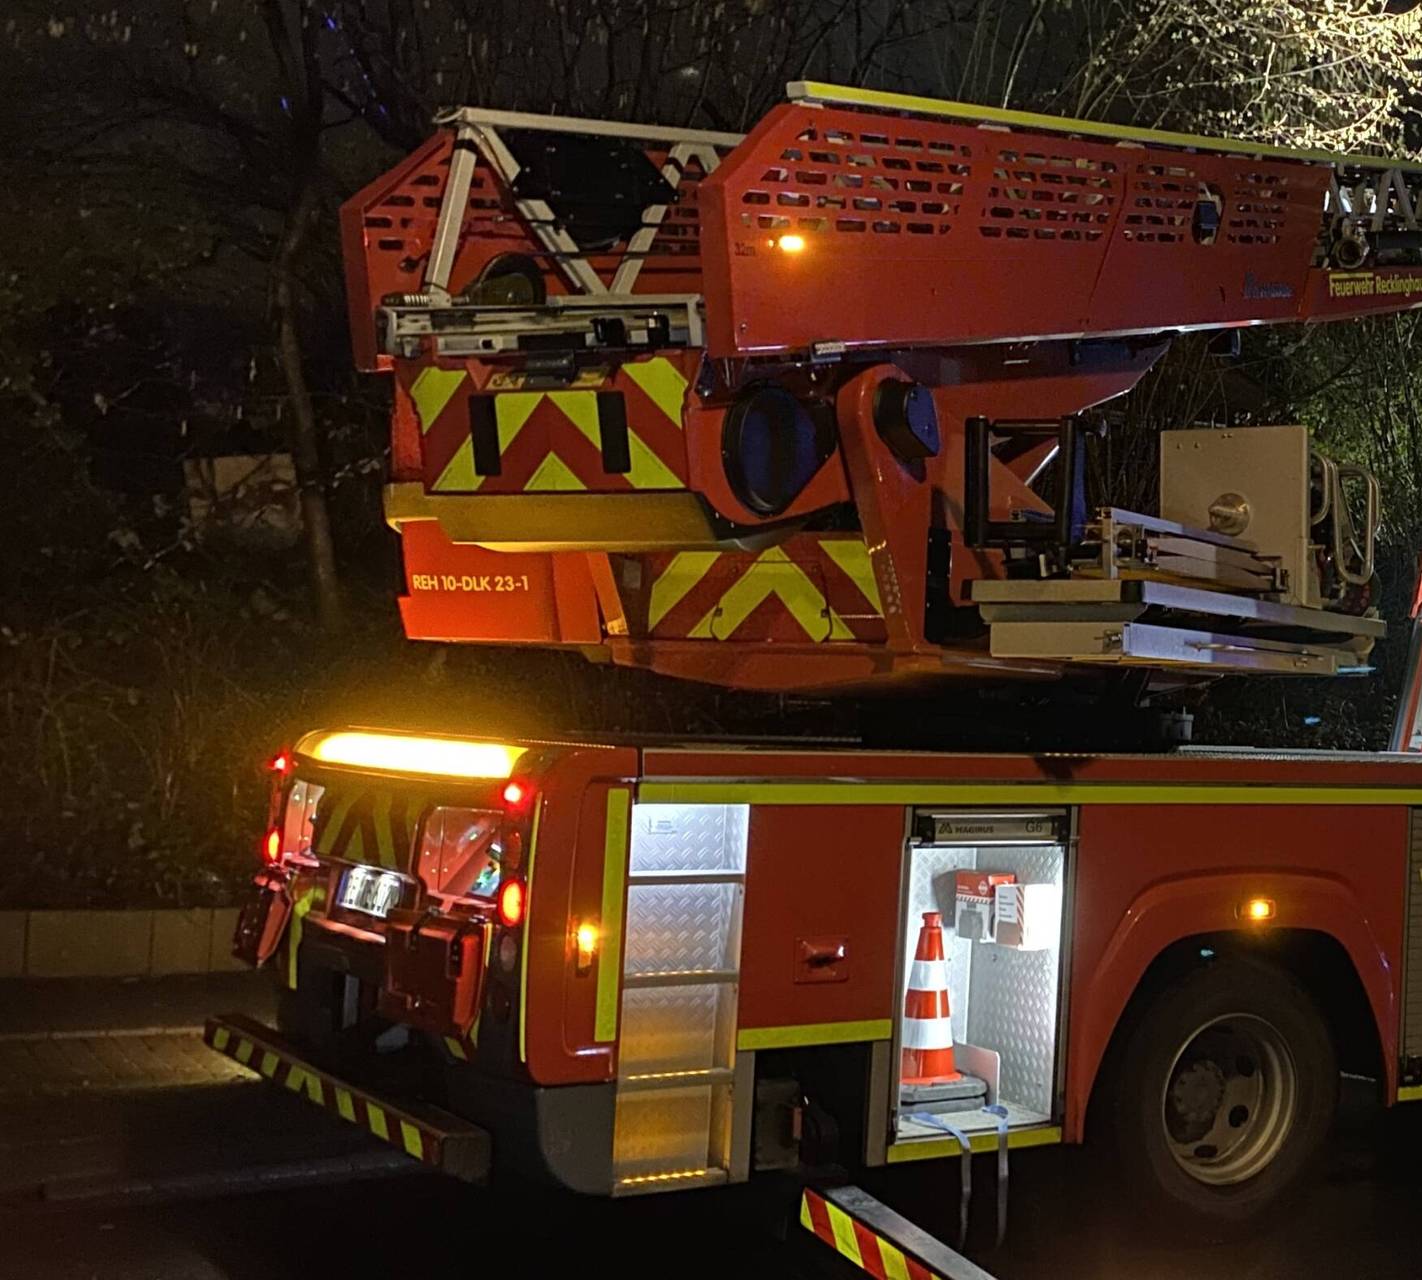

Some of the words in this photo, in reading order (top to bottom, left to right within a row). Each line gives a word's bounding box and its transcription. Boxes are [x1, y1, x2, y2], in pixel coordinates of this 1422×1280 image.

[1329, 272, 1374, 297] Feuerwehr
[412, 574, 439, 591] REH
[441, 575, 492, 592] 10-DLK
[494, 575, 529, 592] 23-1
[955, 825, 994, 834] MAGIRUS
